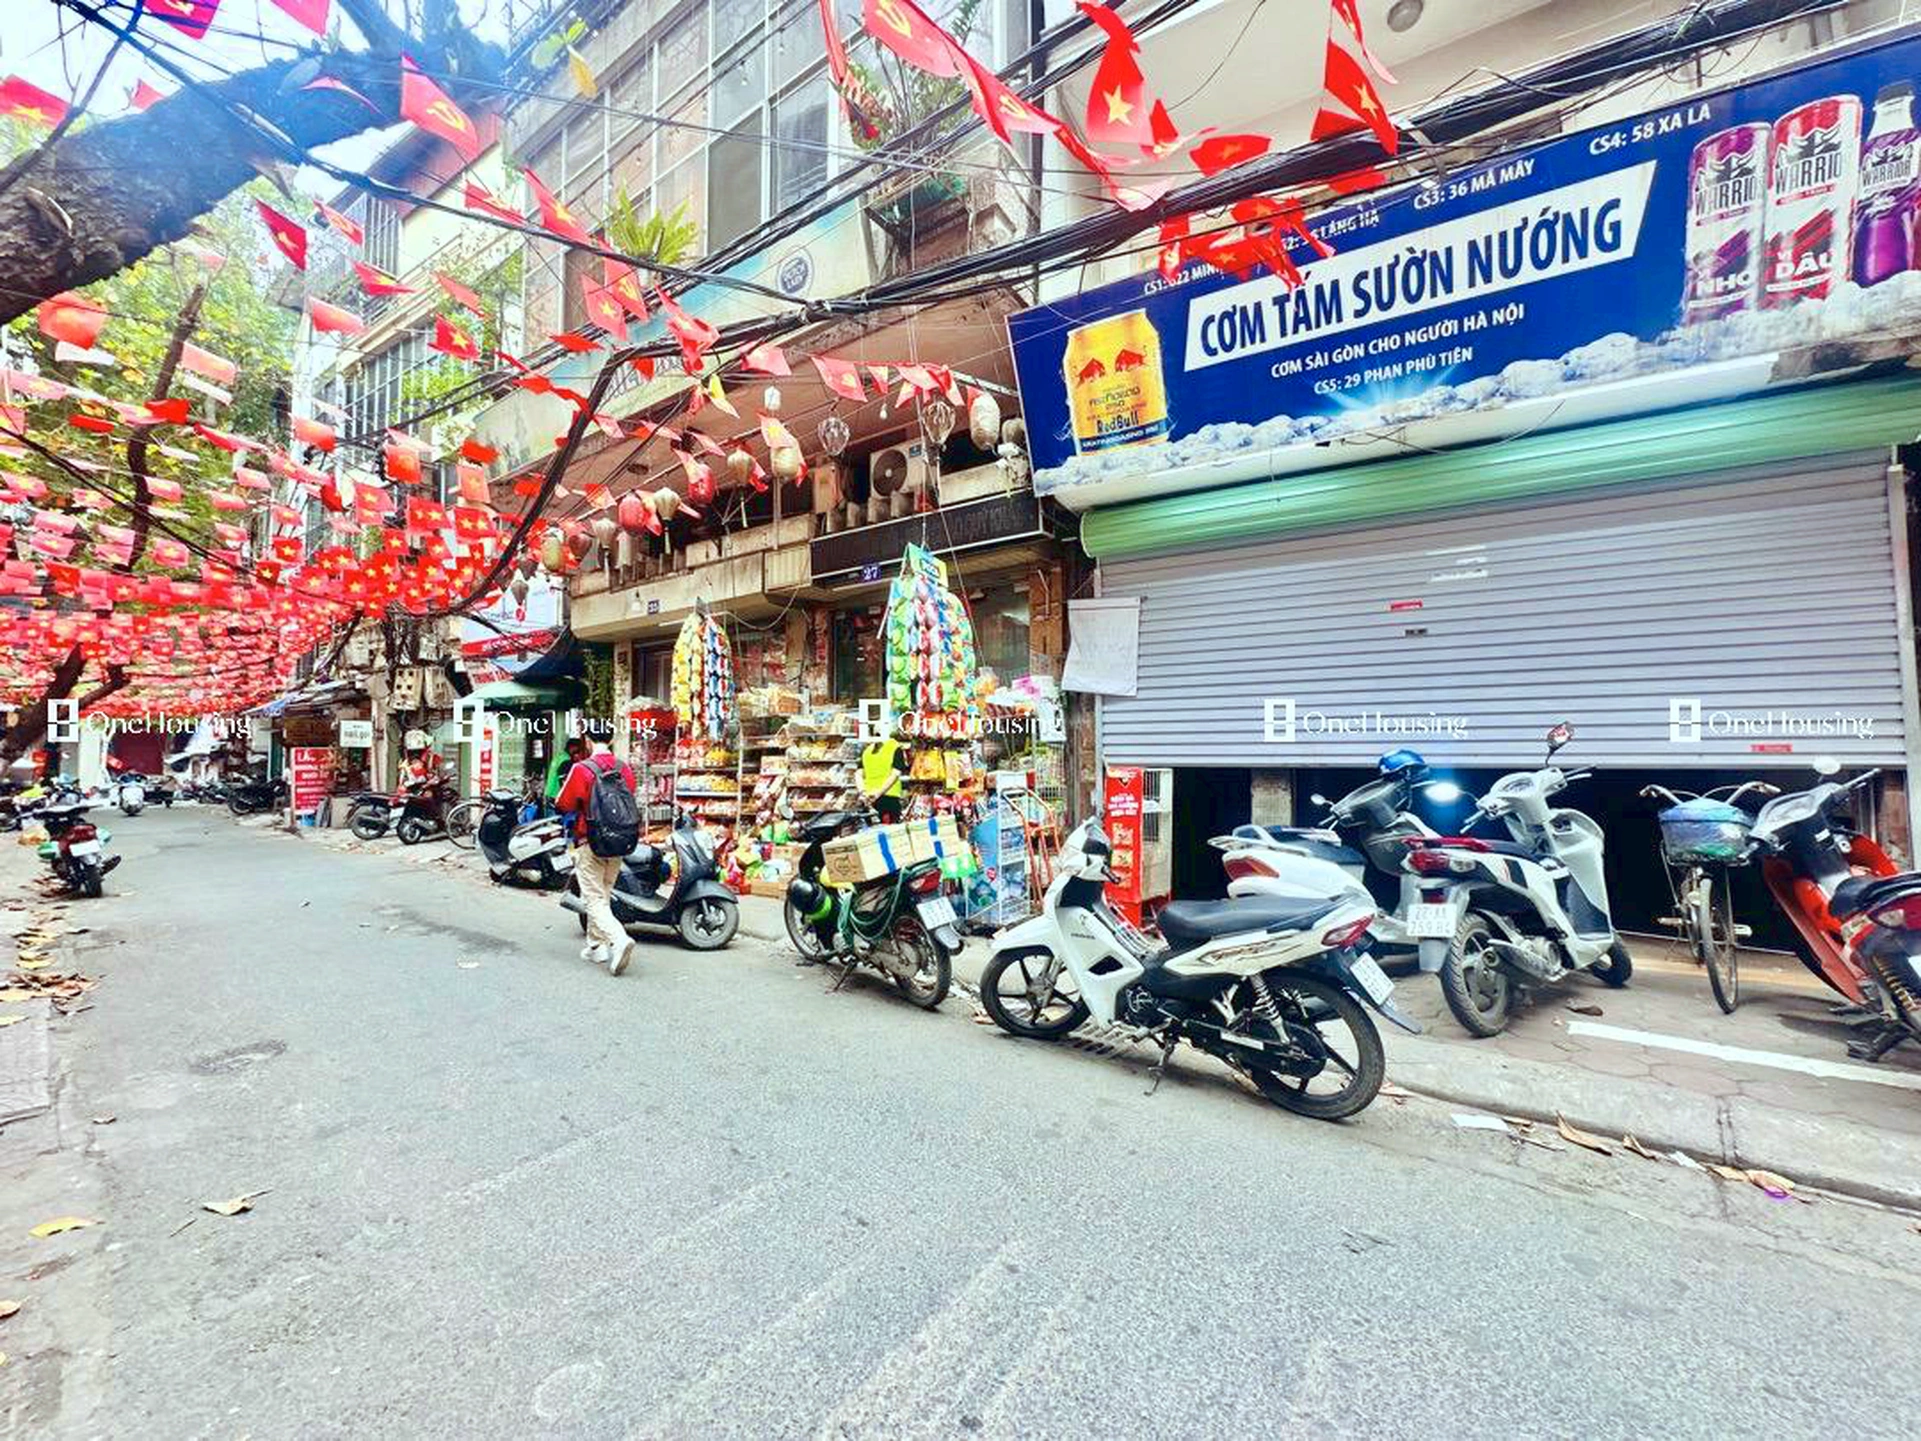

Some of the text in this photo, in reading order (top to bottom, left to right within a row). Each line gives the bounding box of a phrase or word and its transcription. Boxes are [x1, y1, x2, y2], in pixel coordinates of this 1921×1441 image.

[1588, 103, 1712, 155] CS4: 58 XA LA
[1413, 188, 1445, 210] CS3:
[1448, 182, 1468, 200] 36
[1499, 158, 1536, 184] MÂY
[1201, 297, 1266, 357] CƠM
[1353, 247, 1455, 319] SƯỜN
[1468, 198, 1622, 288] NƯỚNG
[1271, 302, 1525, 379] CƠM SÀI GÒN CHO NGƯỜI HÀ NỘI
[1314, 375, 1343, 396] CS5:
[1344, 370, 1362, 389] 29
[1364, 362, 1404, 385] PHAN
[1438, 346, 1474, 368] TIÊN
[863, 566, 880, 581] 27
